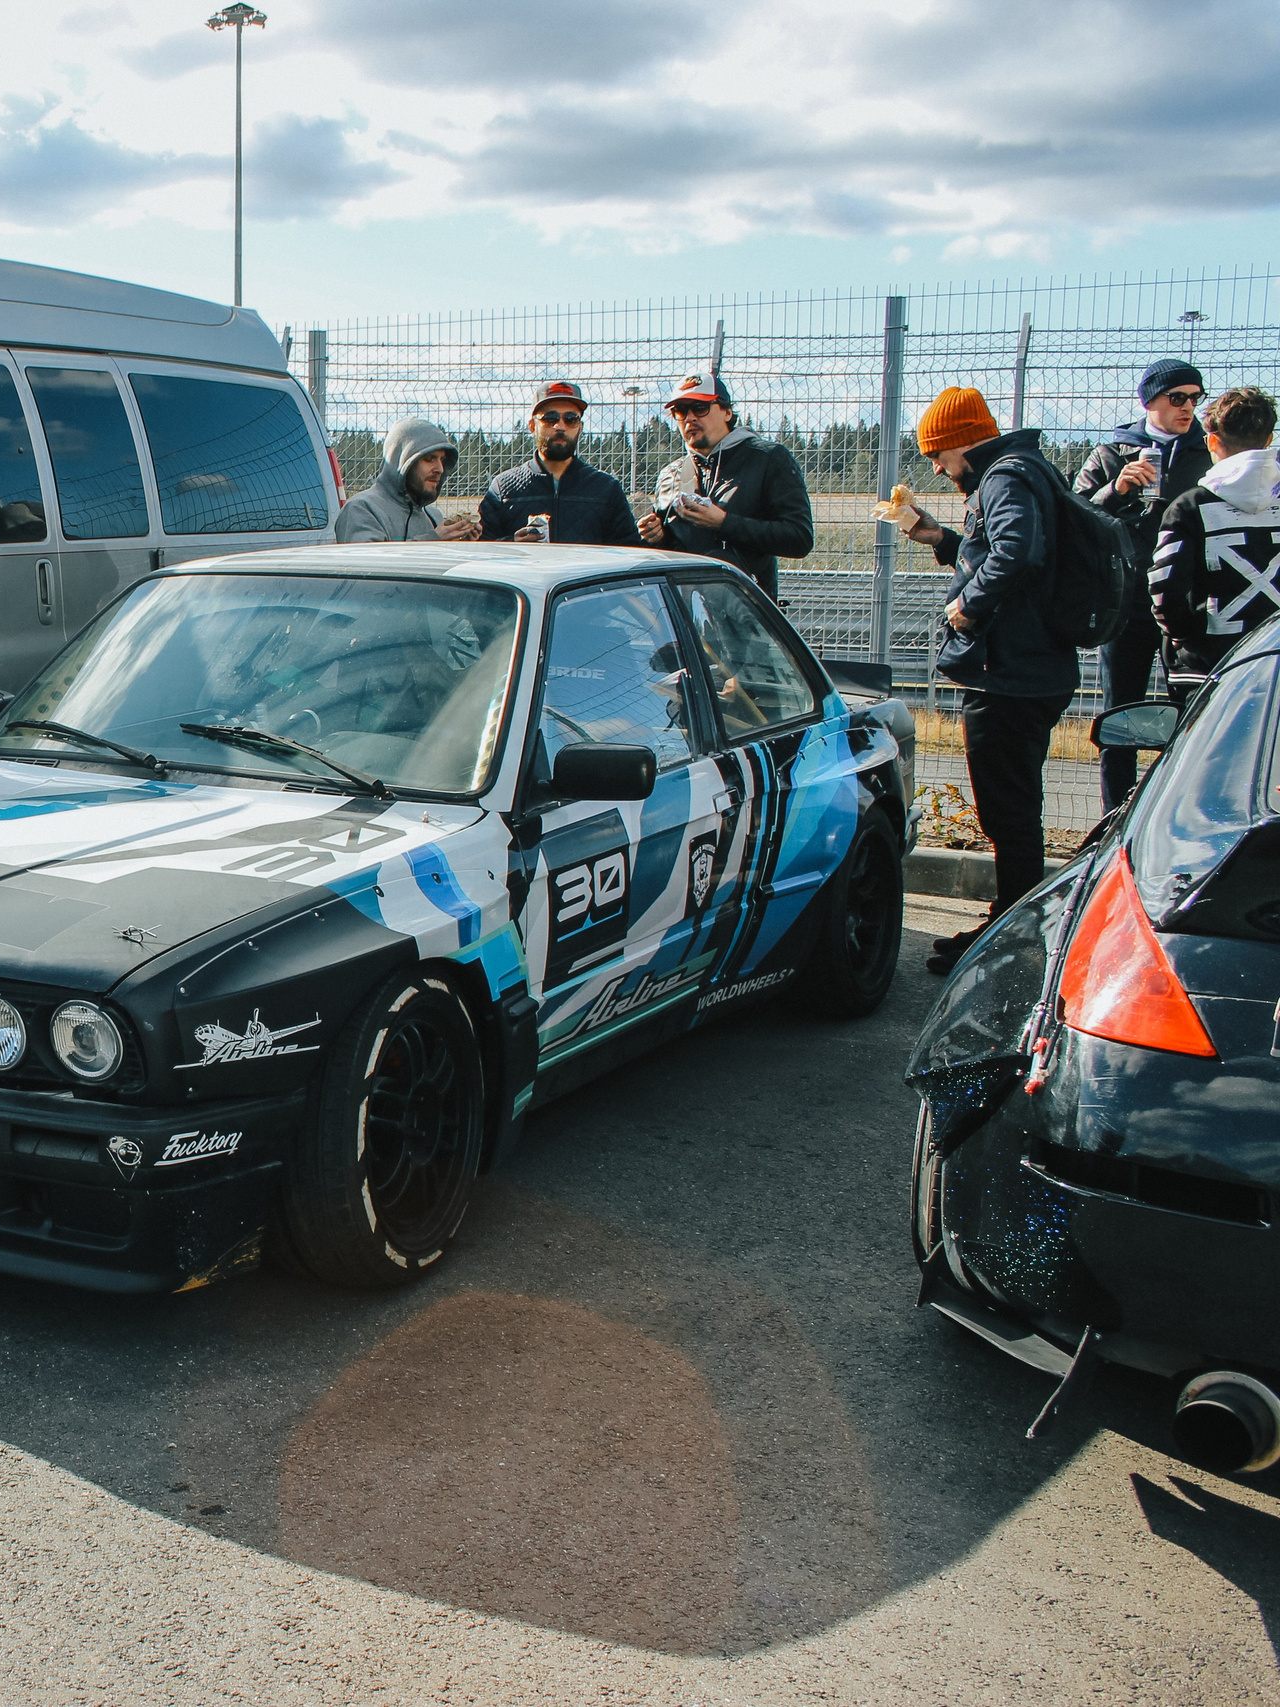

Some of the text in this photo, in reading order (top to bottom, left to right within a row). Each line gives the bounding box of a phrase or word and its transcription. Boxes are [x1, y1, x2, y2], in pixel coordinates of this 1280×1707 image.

[555, 852, 625, 923] 30
[697, 968, 789, 1012] WORLDWHEELS
[159, 1130, 243, 1162] Fucktory
